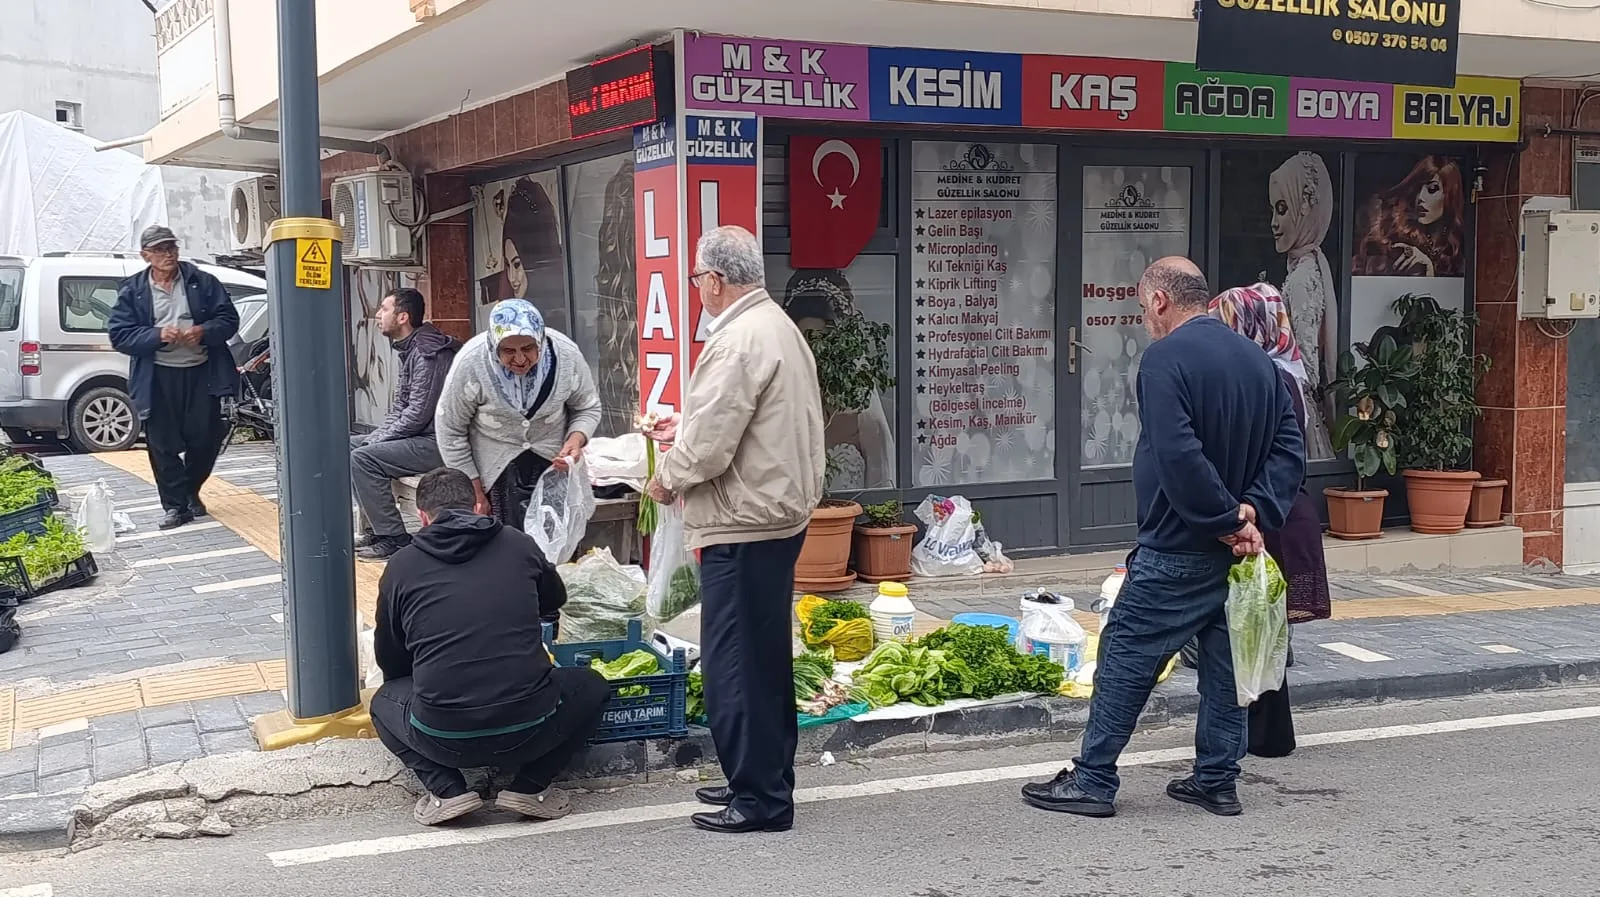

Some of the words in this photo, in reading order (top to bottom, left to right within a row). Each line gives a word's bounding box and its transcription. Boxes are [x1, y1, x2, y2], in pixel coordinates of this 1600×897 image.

[1347, 0, 1446, 27] SALONU
[1345, 30, 1379, 46] 0507
[1382, 33, 1407, 49] 376
[1410, 36, 1427, 50] 54
[1430, 38, 1447, 52] 04
[722, 42, 751, 72] M
[762, 45, 793, 74] &
[801, 47, 827, 76] K
[691, 71, 859, 110] GÜZELLİK
[888, 61, 1003, 110] KESİM
[1051, 72, 1138, 121] KAŞ
[1174, 76, 1277, 120] AĞDA
[1296, 88, 1381, 121] BOYA
[1402, 90, 1513, 129] BALYAJ
[642, 126, 650, 143] M
[651, 124, 658, 140] &
[660, 121, 667, 139] K
[698, 119, 710, 136] M
[715, 119, 726, 136] &
[731, 120, 741, 137] K
[635, 139, 675, 164] GÜZELLİK
[686, 137, 754, 159] GÜZELLİK
[937, 173, 974, 185] MEDİNE
[976, 177, 983, 185] &
[986, 175, 1022, 185] KUDRET
[937, 187, 981, 198] GÜZELLİK
[983, 188, 1020, 198] SALONU
[928, 207, 958, 219] Lazer
[960, 206, 1012, 222] epilasyon
[1100, 210, 1127, 219] MEDİNE
[928, 224, 956, 237] Gelin
[959, 224, 983, 239] Başı
[1100, 221, 1131, 231] GÜZELLİK
[1132, 222, 1160, 231] SALONU
[928, 242, 998, 257] Microplading
[928, 260, 942, 273] Kıl
[945, 259, 984, 275] Tekniği
[987, 259, 1008, 274] Kaş
[928, 278, 960, 293] Kiprik
[963, 277, 997, 291] Lifting
[928, 295, 956, 310] Boya
[965, 294, 999, 310] Balyaj
[928, 312, 959, 325] Kalıcı
[961, 312, 999, 327] Makyaj
[1086, 315, 1117, 327] 0507
[1120, 315, 1143, 326] 376
[928, 330, 992, 344] Profesyonel
[995, 328, 1014, 341] Cilt
[1016, 327, 1051, 340] Bakımı
[928, 347, 988, 363] Hydrafacial
[991, 346, 1010, 358] Cilt
[1012, 345, 1048, 357] Bakımı
[928, 364, 978, 380] Kimyasal
[980, 363, 1020, 376] Peeling
[928, 382, 985, 397] Heykeltraş
[929, 398, 979, 415] (Bölgesel
[982, 396, 1026, 411] incelme)
[929, 417, 966, 430] Kesim,
[969, 415, 992, 430] Kaş,
[995, 412, 1037, 426] Manikür
[929, 434, 957, 449] Ağda
[634, 706, 665, 720] TARIM
